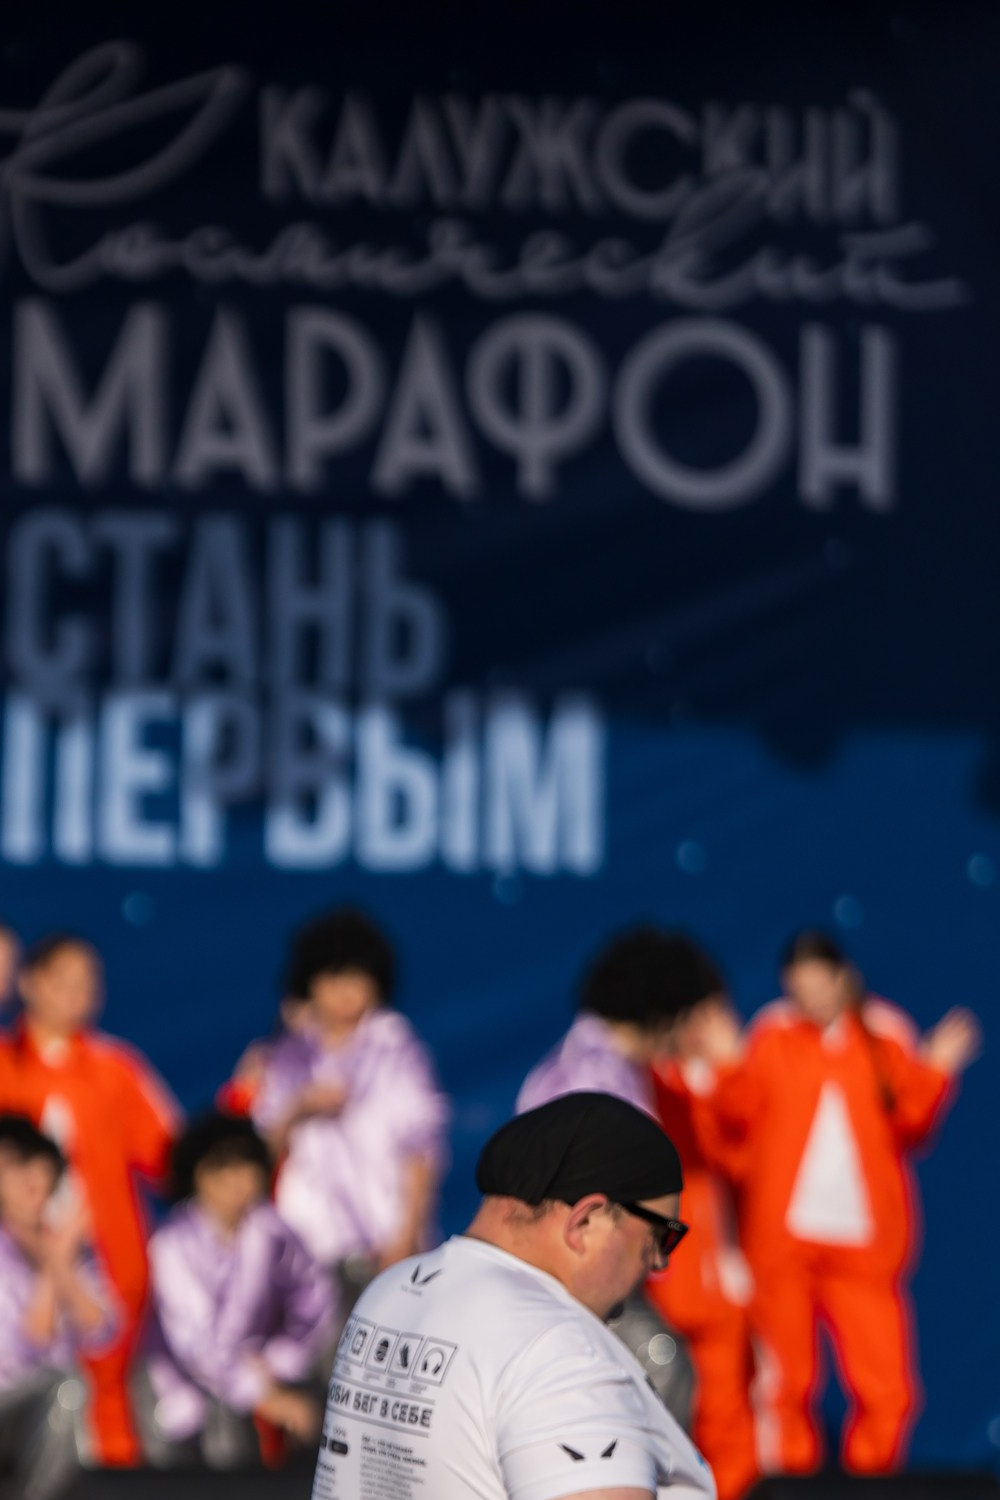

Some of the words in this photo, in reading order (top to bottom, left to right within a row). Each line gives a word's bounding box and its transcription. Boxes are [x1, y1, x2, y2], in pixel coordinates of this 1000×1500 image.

[258, 88, 898, 224] КАЛУЖСКИЙ
[11, 299, 899, 510] МАРАФОН
[4, 508, 450, 698] СТАНЬ
[353, 1391, 377, 1414] БЕГ
[379, 1399, 389, 1418] В
[391, 1402, 432, 1428] СЕБЕ
